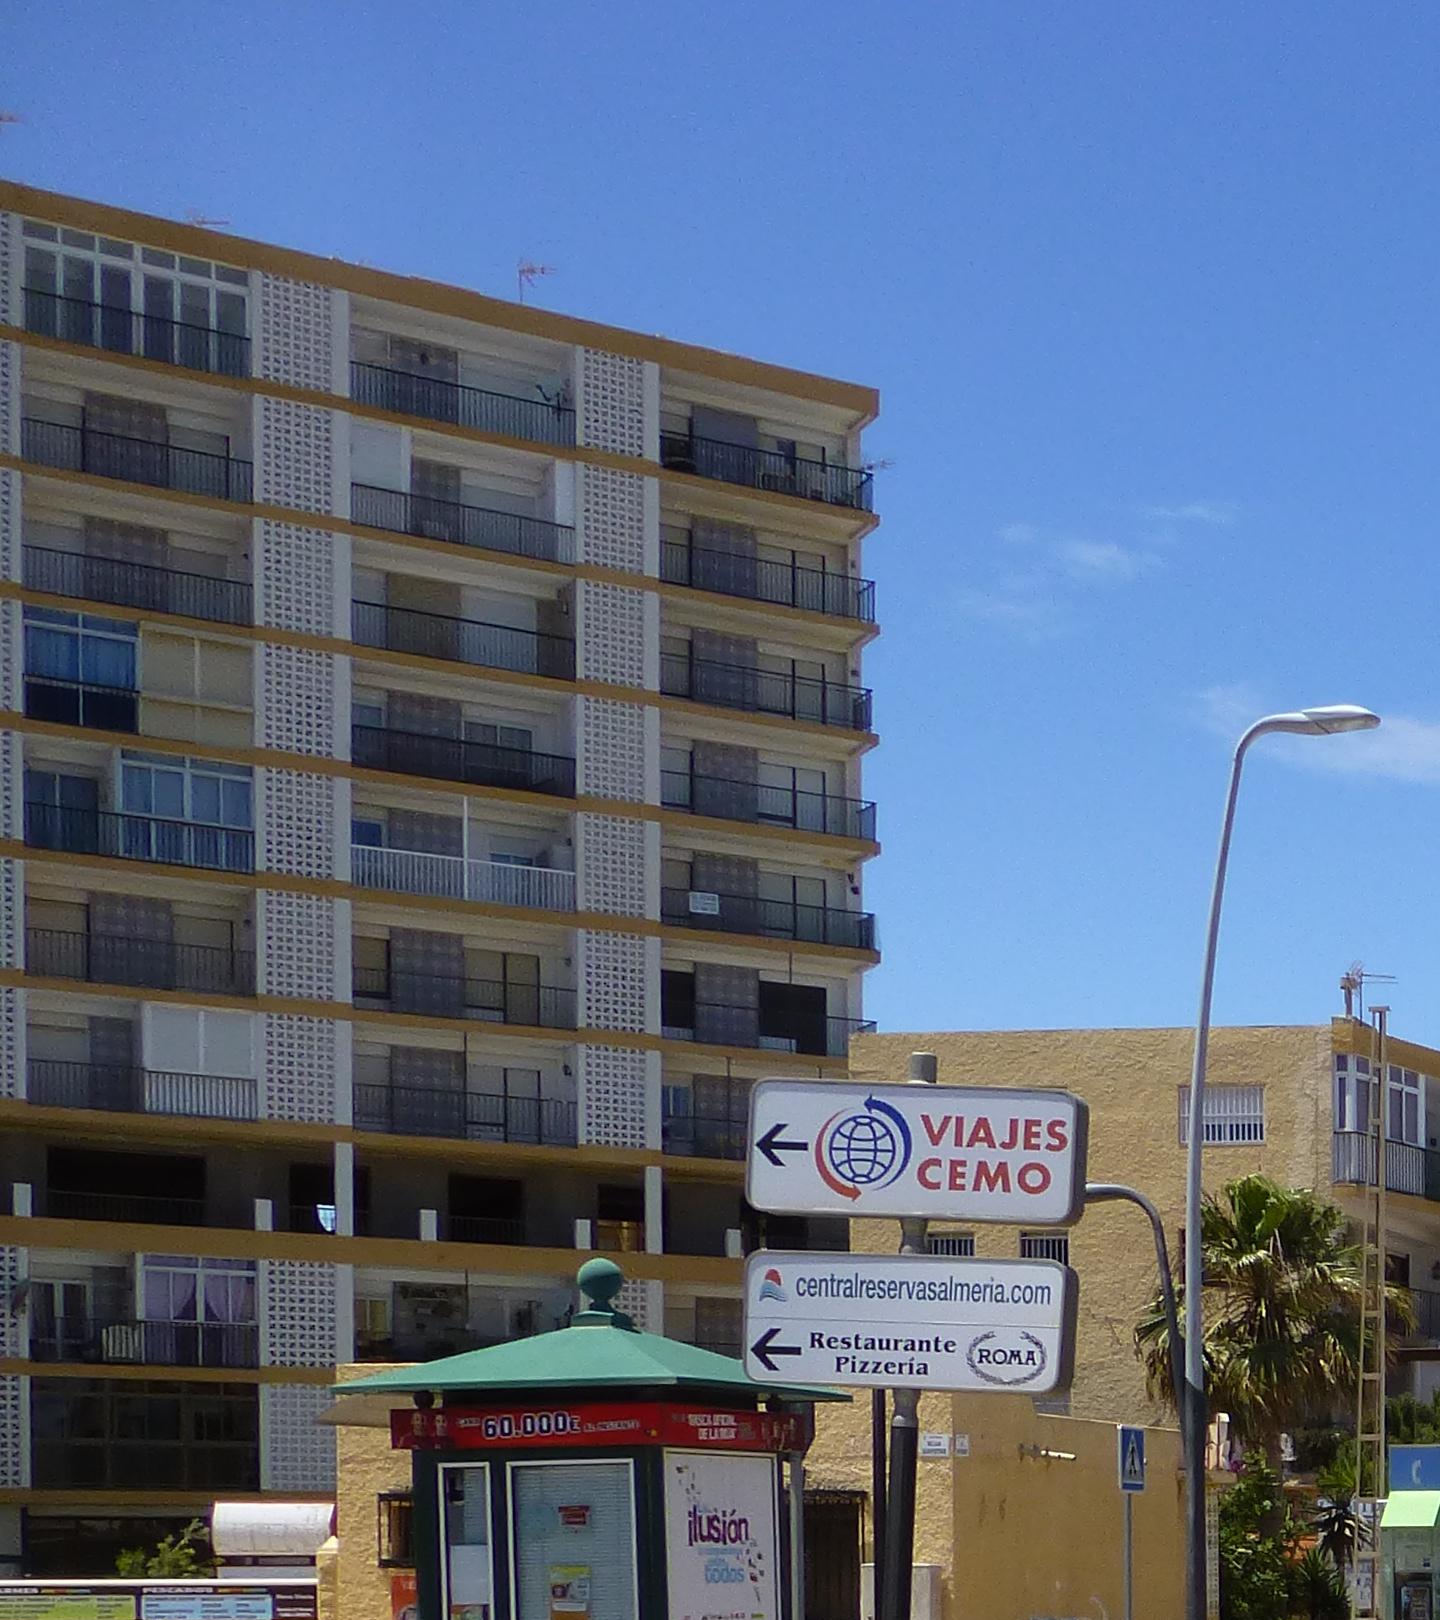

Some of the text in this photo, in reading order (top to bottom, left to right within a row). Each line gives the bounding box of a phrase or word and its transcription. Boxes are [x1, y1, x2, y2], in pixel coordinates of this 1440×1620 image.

[920, 1114, 1068, 1152] VIAJES
[917, 1158, 1052, 1194] CEMO
[796, 1273, 1051, 1305] centralreservasalmeria.com
[810, 1332, 957, 1353] Restaurante
[977, 1349, 1037, 1366] ROMA
[835, 1356, 929, 1376] Pizzería
[688, 1505, 749, 1547] ilusión
